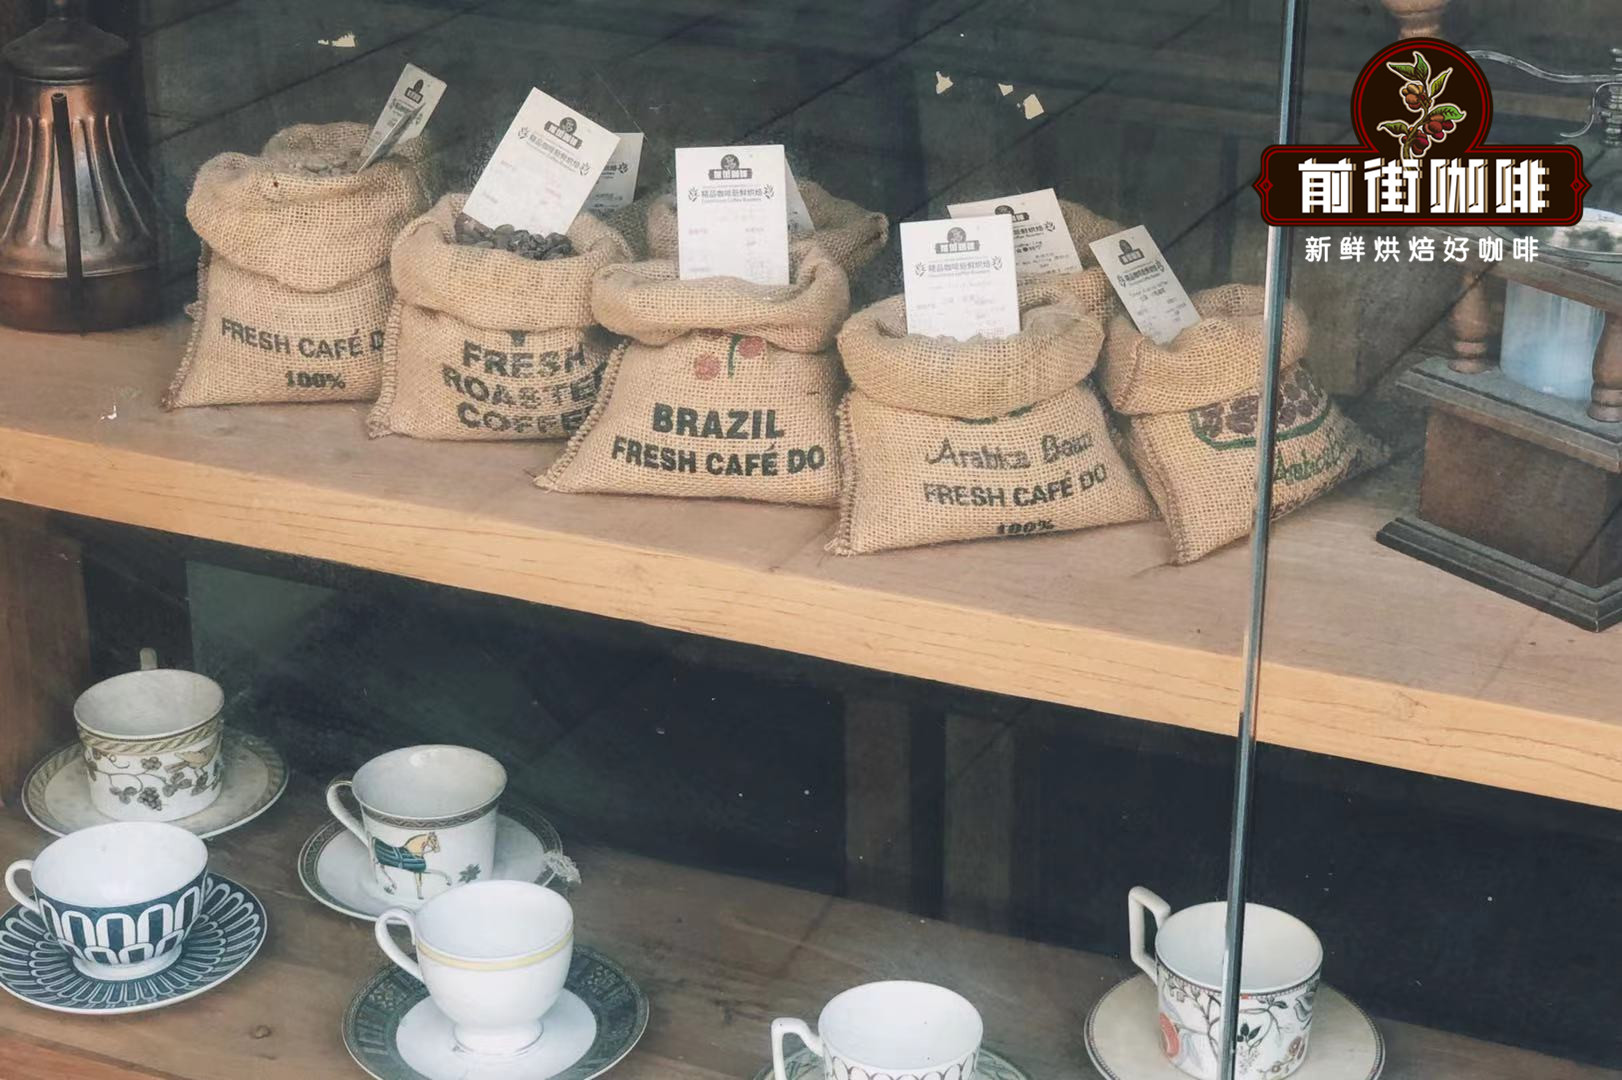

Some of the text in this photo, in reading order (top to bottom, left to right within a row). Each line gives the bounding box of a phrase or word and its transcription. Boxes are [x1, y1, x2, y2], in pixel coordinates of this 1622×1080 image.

[221, 317, 384, 359] FRESH CAFÉ D
[463, 339, 586, 379] FRESH
[286, 370, 346, 390] 100%
[456, 401, 594, 433] COFFE
[652, 402, 785, 440] BRAZIL
[611, 435, 825, 476] FRESH CAFÉ DO
[923, 463, 1107, 507] FRESH CAFÉ DO
